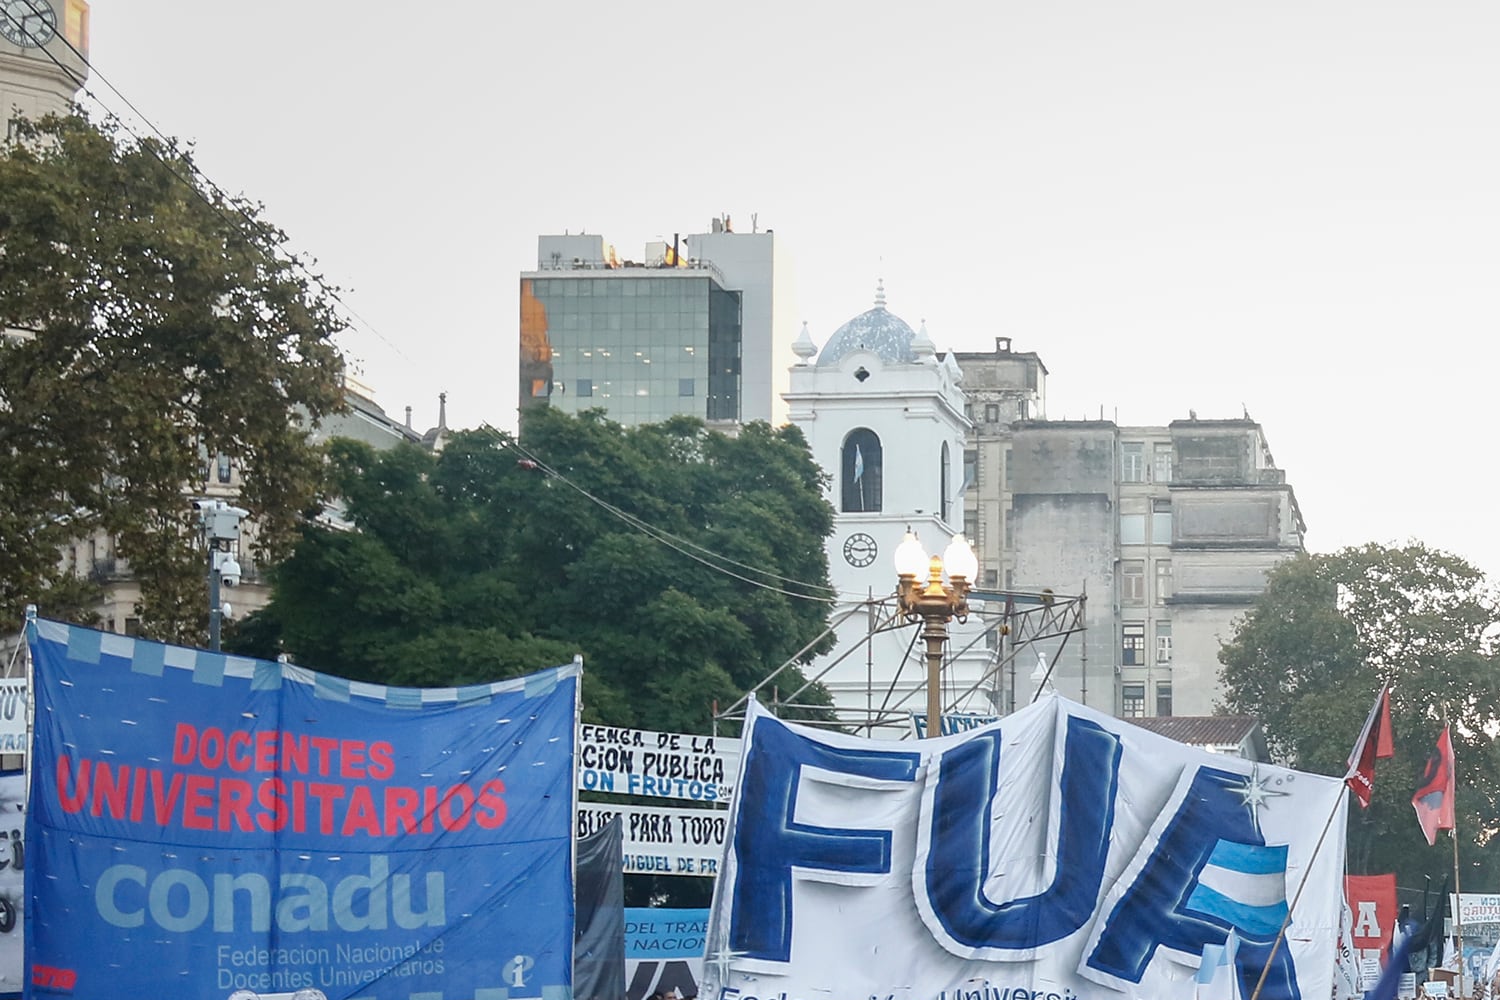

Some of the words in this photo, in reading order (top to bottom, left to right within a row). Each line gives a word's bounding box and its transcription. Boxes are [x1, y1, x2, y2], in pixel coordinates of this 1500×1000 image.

[172, 722, 395, 780] DOCENTES
[658, 734, 680, 750] DE
[692, 738, 715, 754] LA
[56, 754, 508, 838] UNIVERSITARIOS
[579, 770, 614, 791] ON
[628, 774, 718, 800] FRUTOS
[630, 813, 673, 843] PARA
[678, 858, 694, 872] DE
[95, 855, 446, 933] conadu
[217, 944, 329, 967] Federacion
[337, 940, 420, 963] Nacional
[217, 968, 313, 989] Docentes
[320, 958, 444, 987] Univertarios
